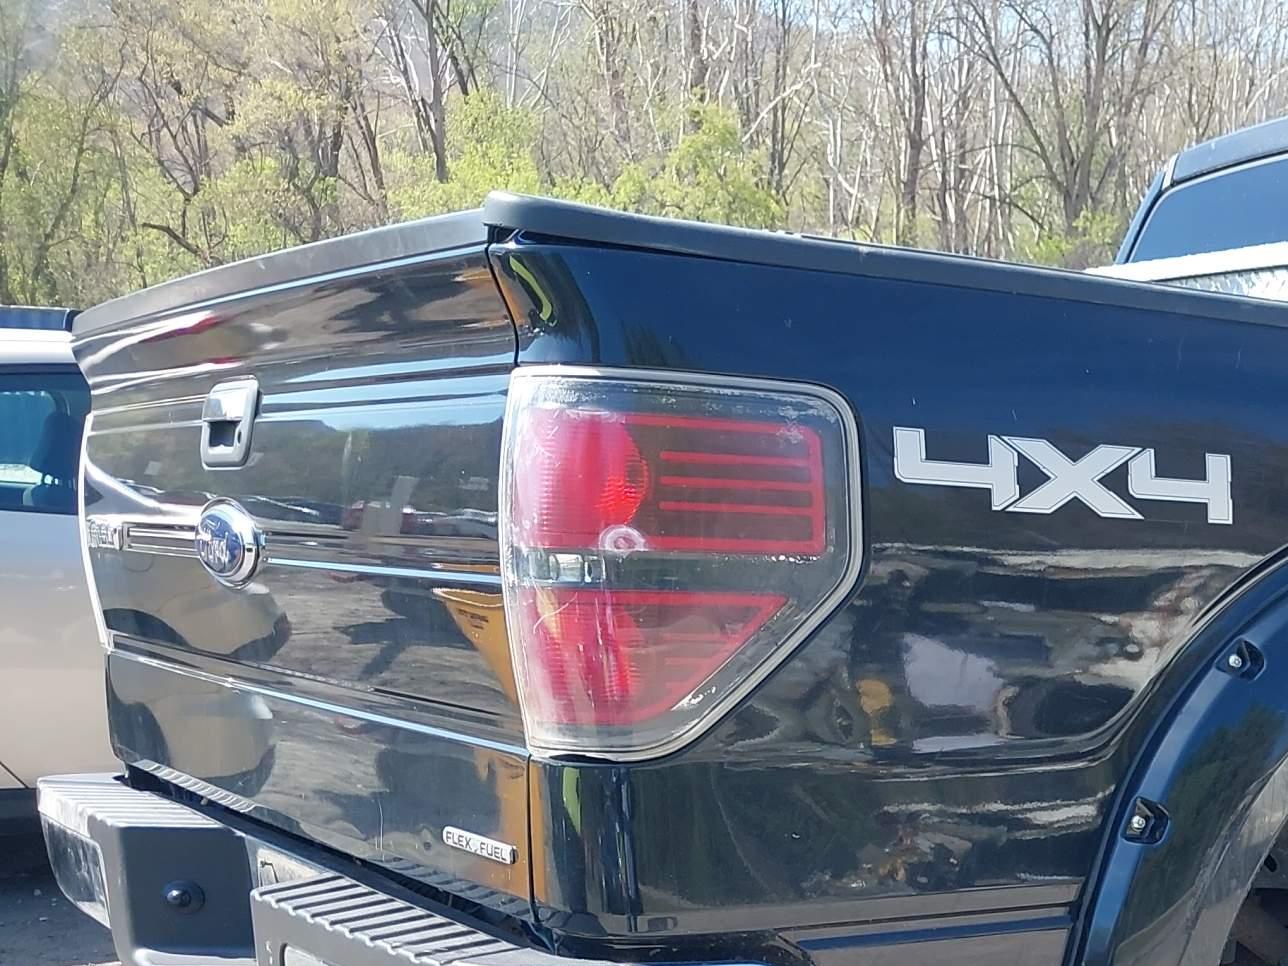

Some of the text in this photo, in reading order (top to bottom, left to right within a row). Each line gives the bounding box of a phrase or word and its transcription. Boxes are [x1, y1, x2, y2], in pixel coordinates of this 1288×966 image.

[893, 426, 1233, 525] 4X4
[200, 520, 230, 568] Ford
[446, 830, 507, 862] FLEX FUEL
